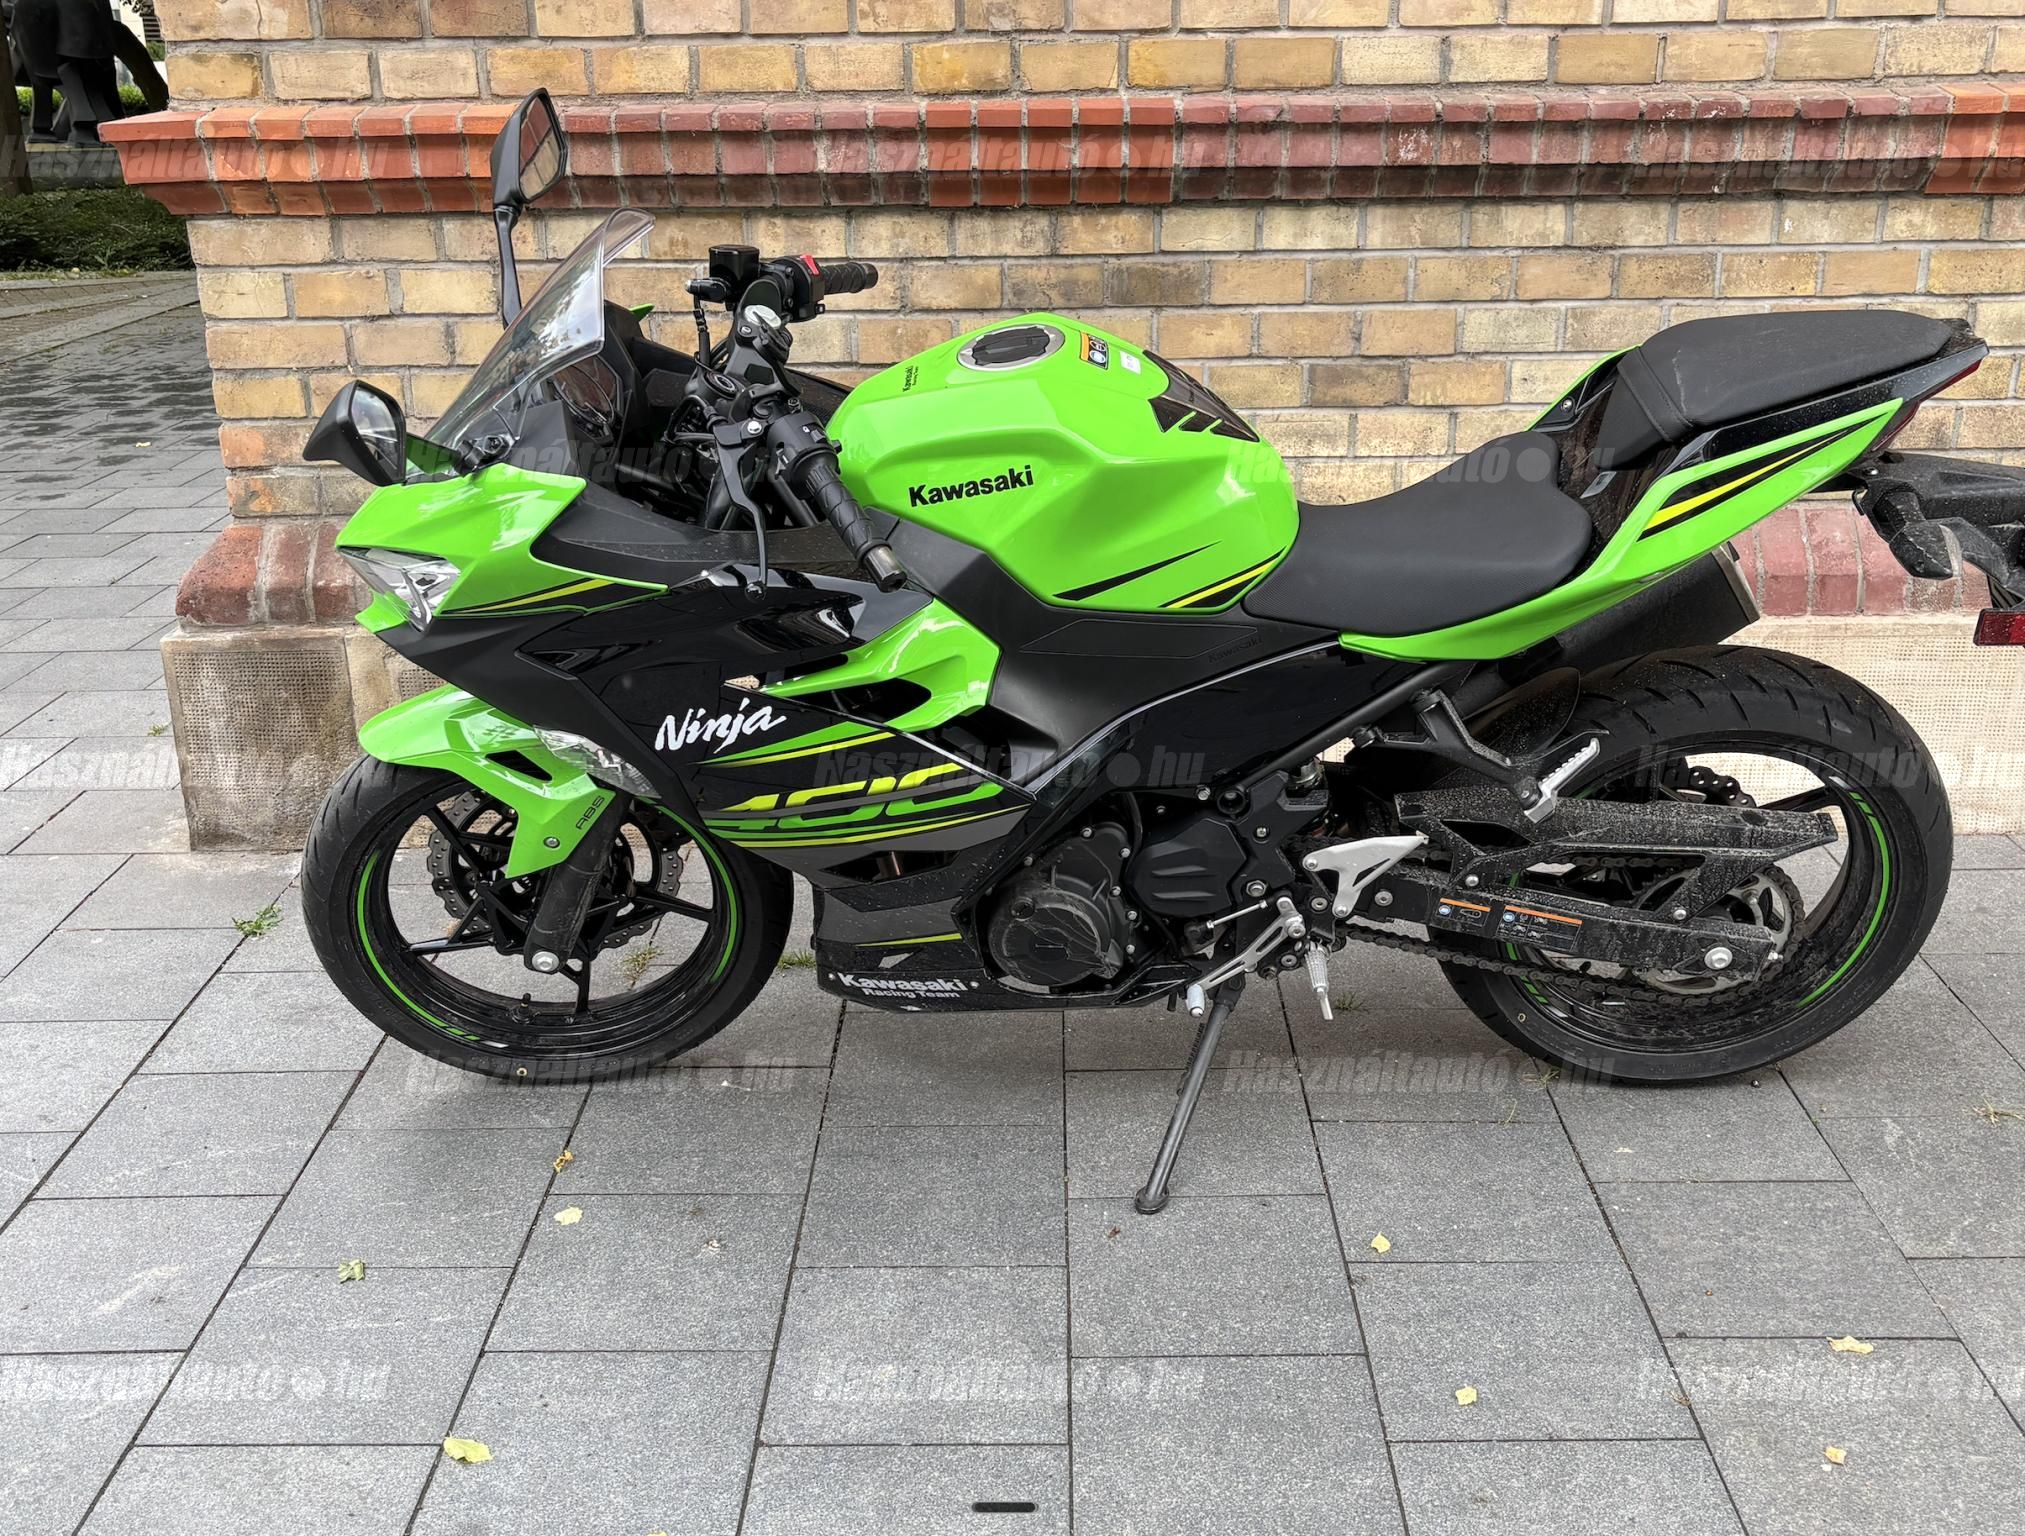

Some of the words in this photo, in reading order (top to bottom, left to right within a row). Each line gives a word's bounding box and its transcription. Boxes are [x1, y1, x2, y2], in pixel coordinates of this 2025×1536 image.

[908, 464, 1035, 507] Kawasaki
[654, 697, 787, 754] Ninja
[576, 795, 605, 830] ABS
[837, 972, 968, 991] Kawasaki
[863, 987, 917, 999] Racing
[916, 989, 961, 999] Team
